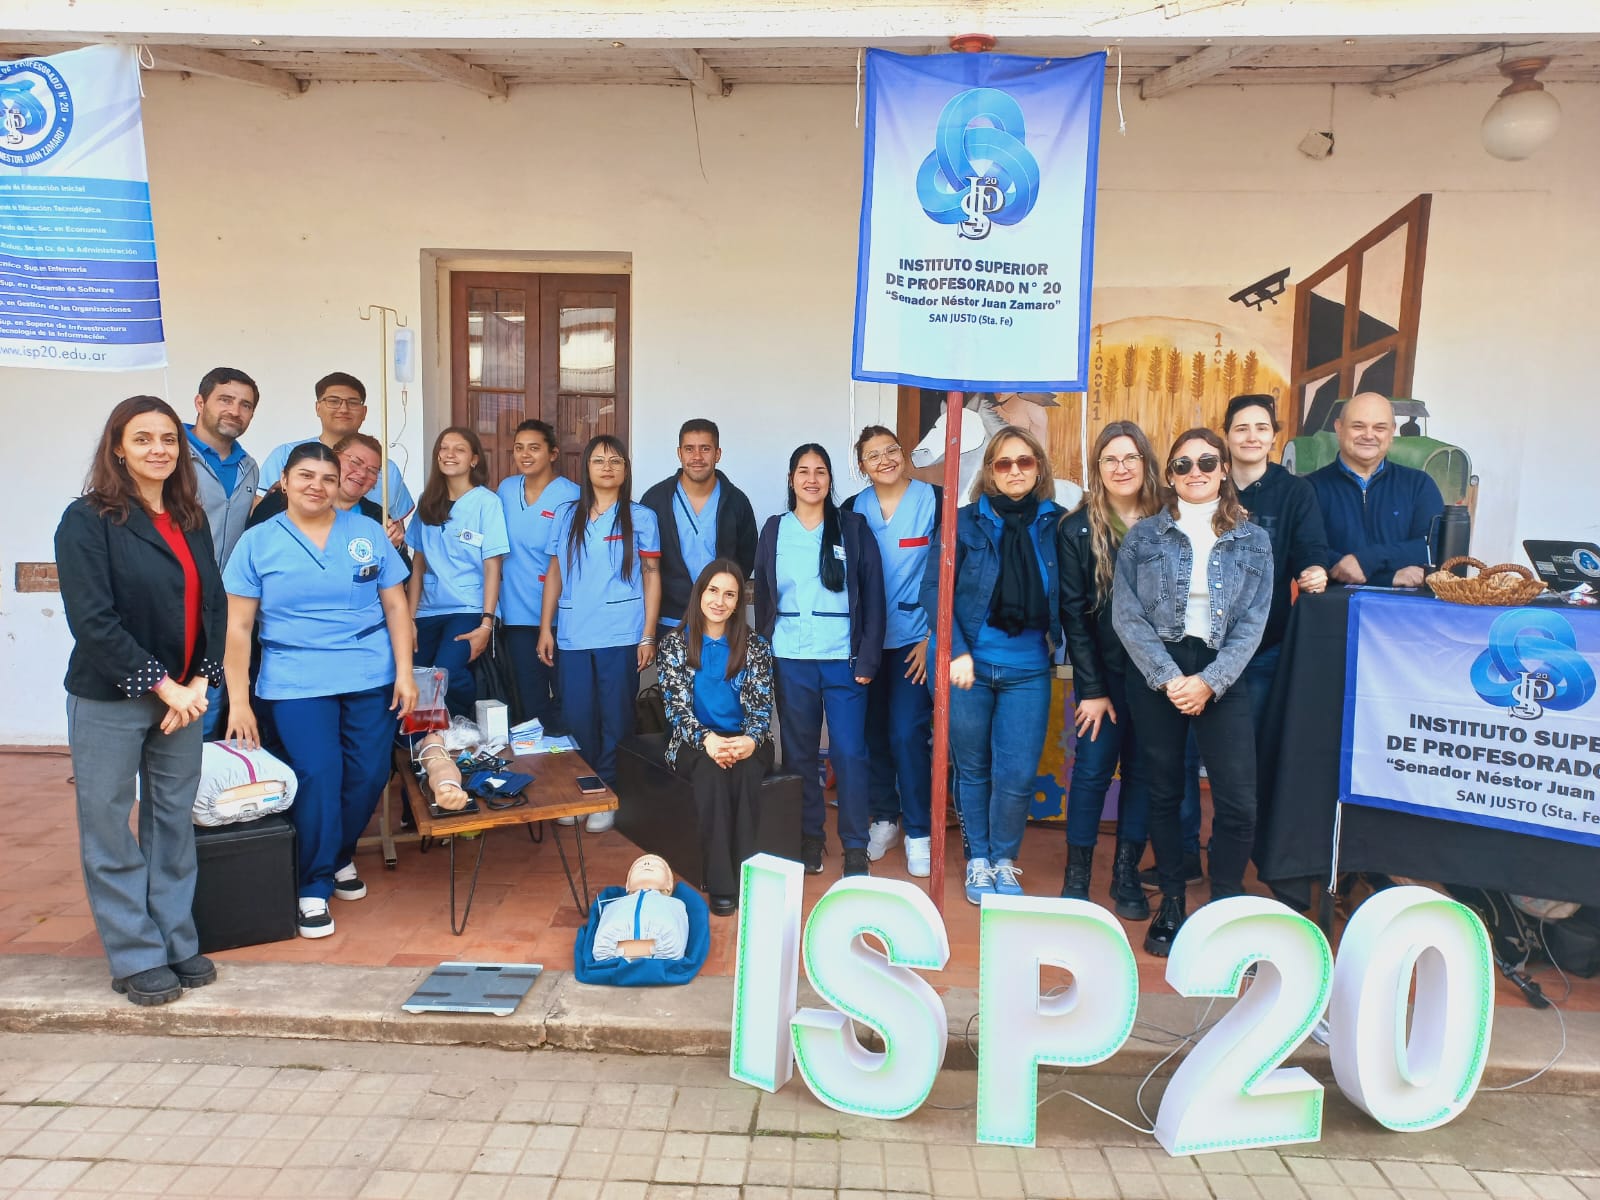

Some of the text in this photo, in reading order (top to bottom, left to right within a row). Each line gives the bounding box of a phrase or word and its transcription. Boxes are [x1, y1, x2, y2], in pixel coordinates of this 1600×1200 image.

[60, 102, 69, 113] 20
[25, 150, 44, 164] JUAN
[60, 184, 86, 193] Inicial
[76, 246, 138, 256] Administración
[47, 265, 88, 273] Enfermería
[899, 258, 1049, 276] INSTITUTO SUPERIOR
[77, 285, 114, 294] Software
[885, 272, 905, 288] DE
[907, 277, 1015, 295] PROFESORADO
[1042, 281, 1062, 295] 20
[16, 299, 47, 309] Gestión
[71, 305, 132, 314] Organizaciones
[941, 294, 980, 307] Néstor
[981, 298, 1007, 310] Juan
[25, 319, 55, 329] Soporte
[68, 324, 127, 333] Infraestructura
[928, 313, 1014, 328] SAN JUSTO (Sta. Fe)
[1409, 713, 1600, 753] INSTITUTO SUPE
[1386, 735, 1417, 753] DE
[1475, 769, 1543, 792] Néstor
[1546, 781, 1595, 801] Juan
[1456, 790, 1486, 805] SAN
[1489, 795, 1538, 814] JUSTO
[1541, 803, 1577, 821] (Sta.
